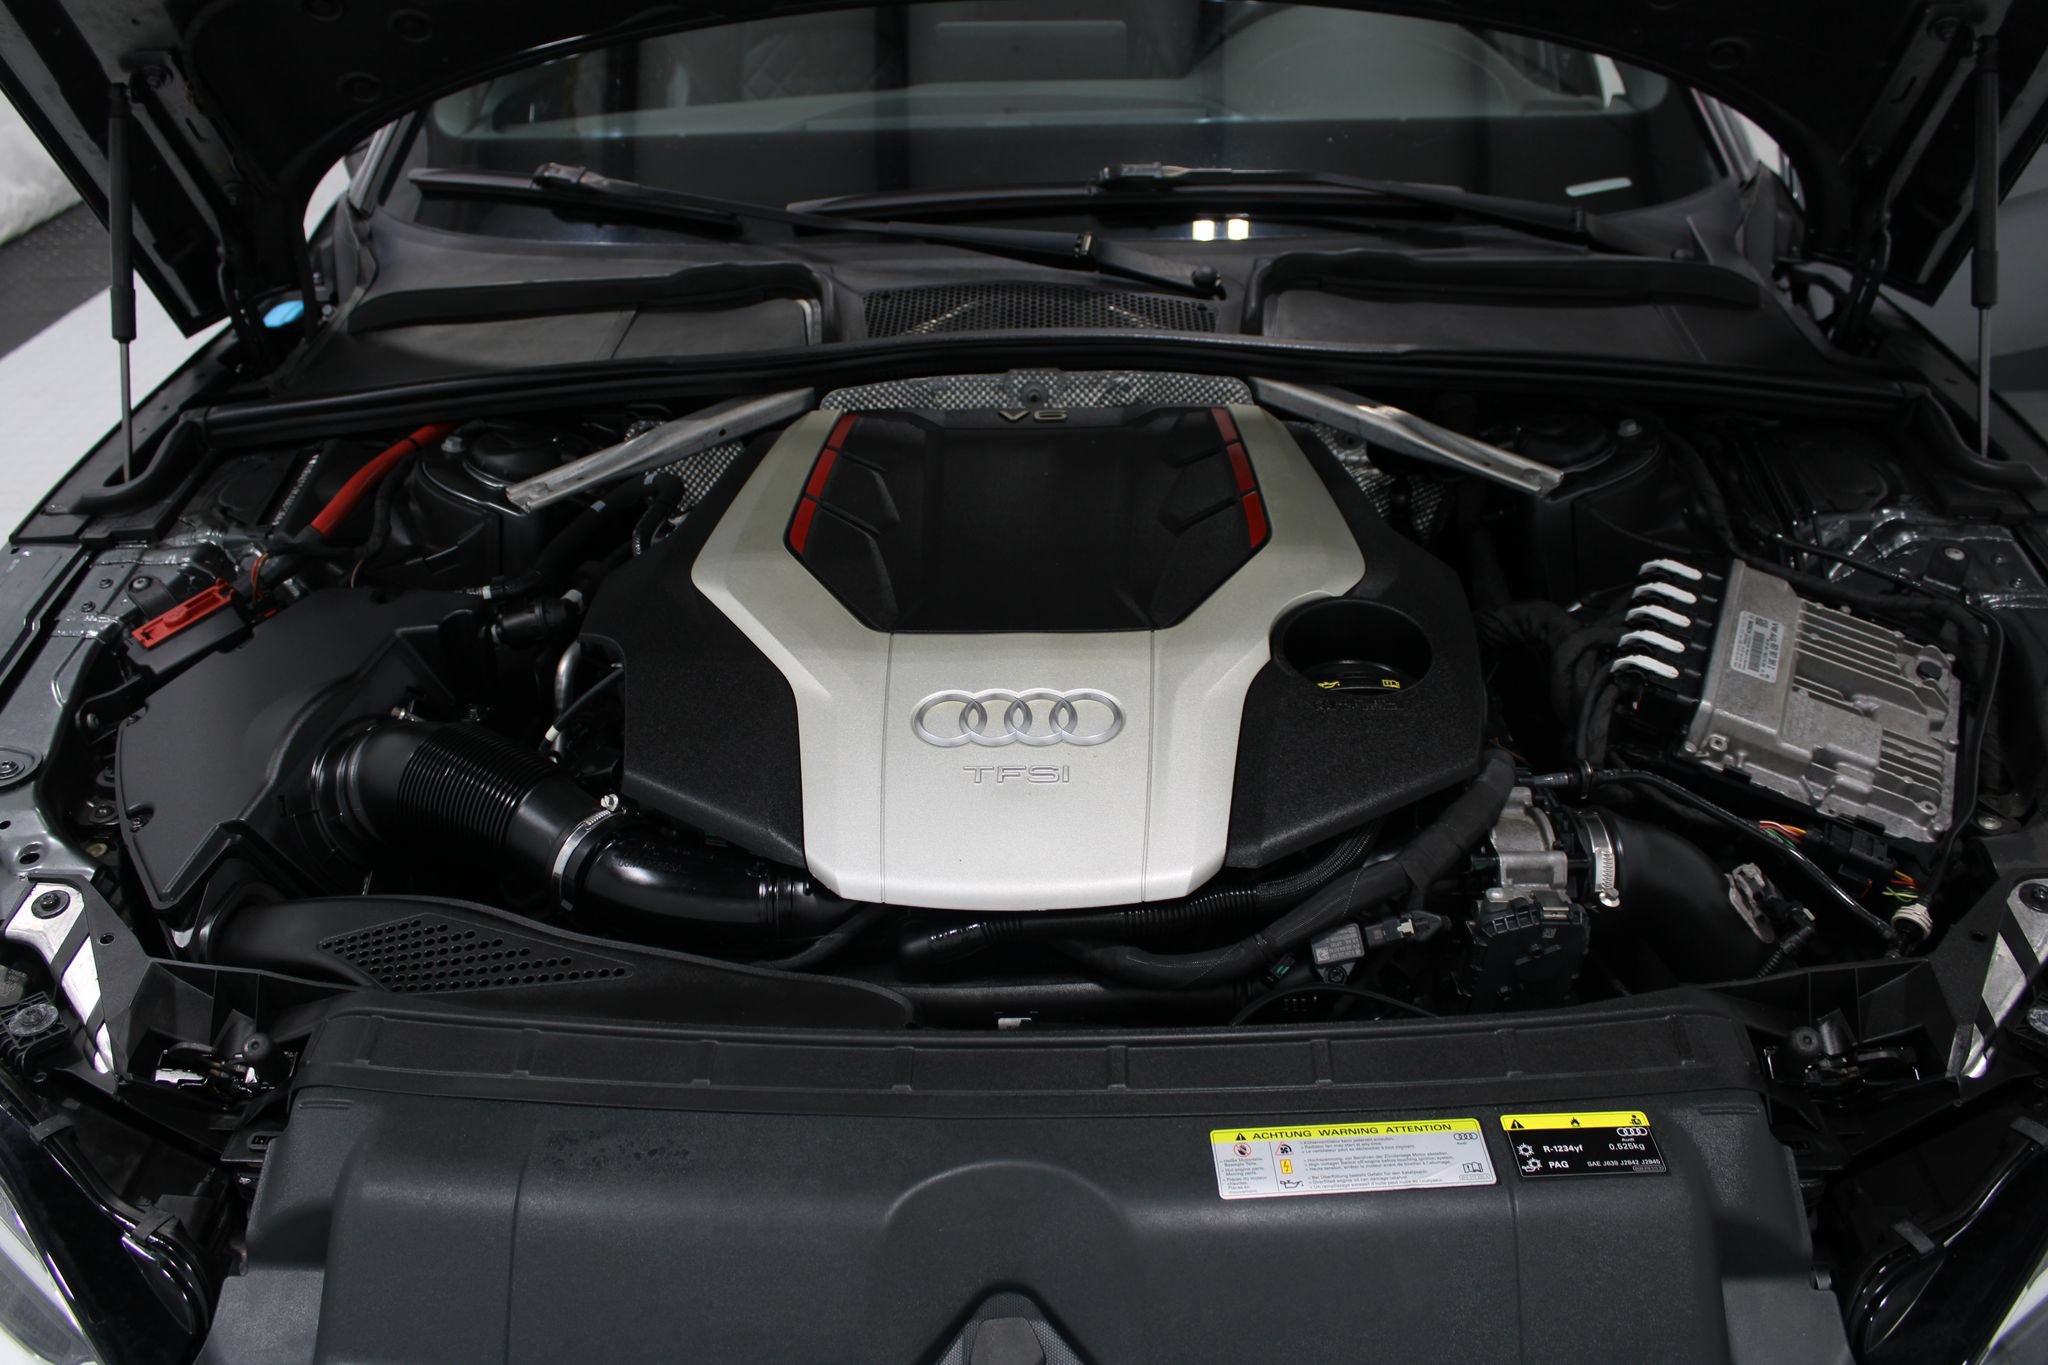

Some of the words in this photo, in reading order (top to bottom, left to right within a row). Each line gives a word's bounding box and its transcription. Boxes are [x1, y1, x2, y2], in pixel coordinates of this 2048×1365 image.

[963, 765, 1070, 783] TFSI
[1252, 1130, 1312, 1140] ACHTUNG
[1318, 1127, 1379, 1136] WARNING
[1385, 1124, 1452, 1134] ATTENTION
[1543, 1144, 1583, 1153] R-1234yf
[1608, 1143, 1645, 1151] 0.525kg
[1548, 1160, 1569, 1169] PAG
